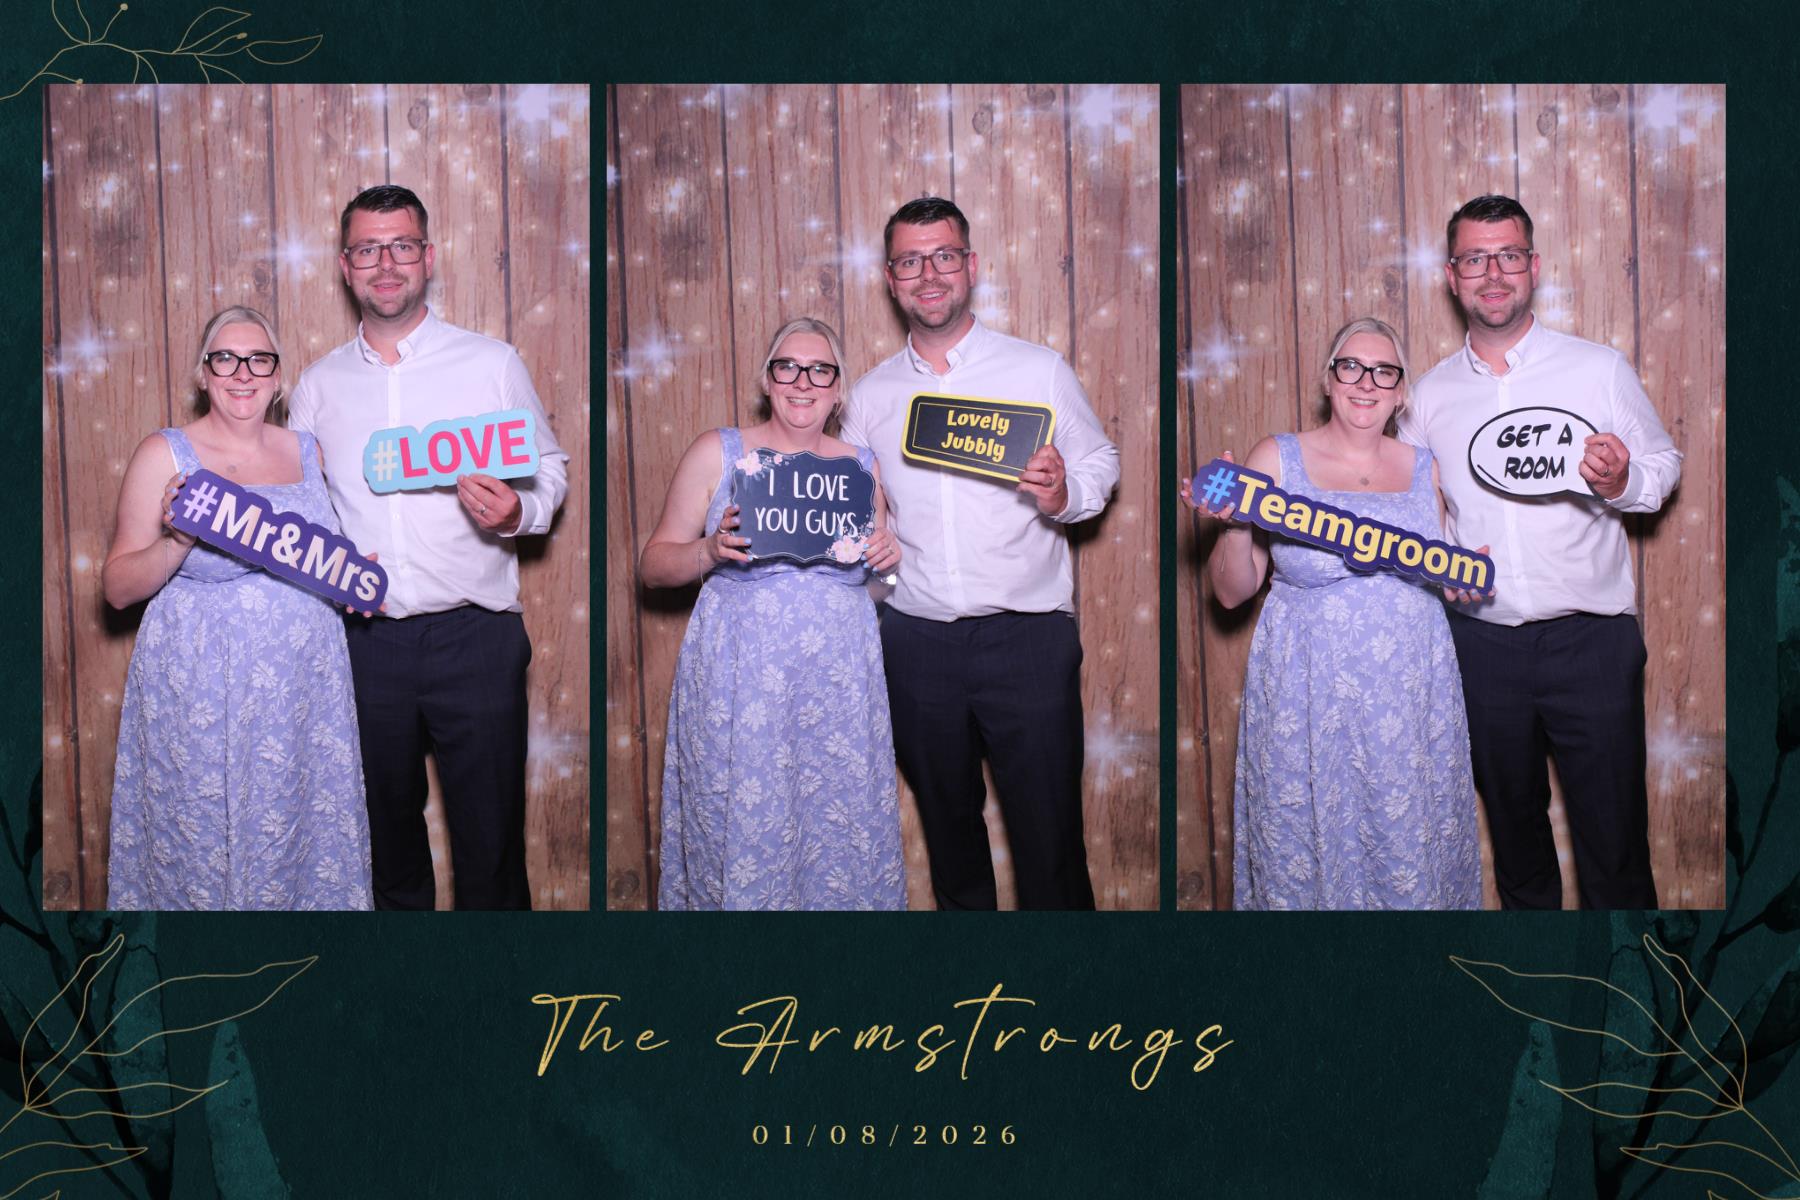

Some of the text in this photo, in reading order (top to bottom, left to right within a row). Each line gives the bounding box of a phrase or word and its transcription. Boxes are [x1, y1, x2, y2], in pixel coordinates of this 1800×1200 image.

[947, 410, 1010, 436] Lovely
[1496, 423, 1573, 449] GET A
[372, 419, 531, 482] #LOVE
[941, 432, 1005, 462] Jubbly
[1504, 456, 1565, 480] ROOM
[768, 469, 850, 501] I LOVE
[755, 507, 858, 538] YOU GUYS
[1202, 467, 1488, 589] #Teamgroom
[183, 481, 382, 602] #Mr&Mrs
